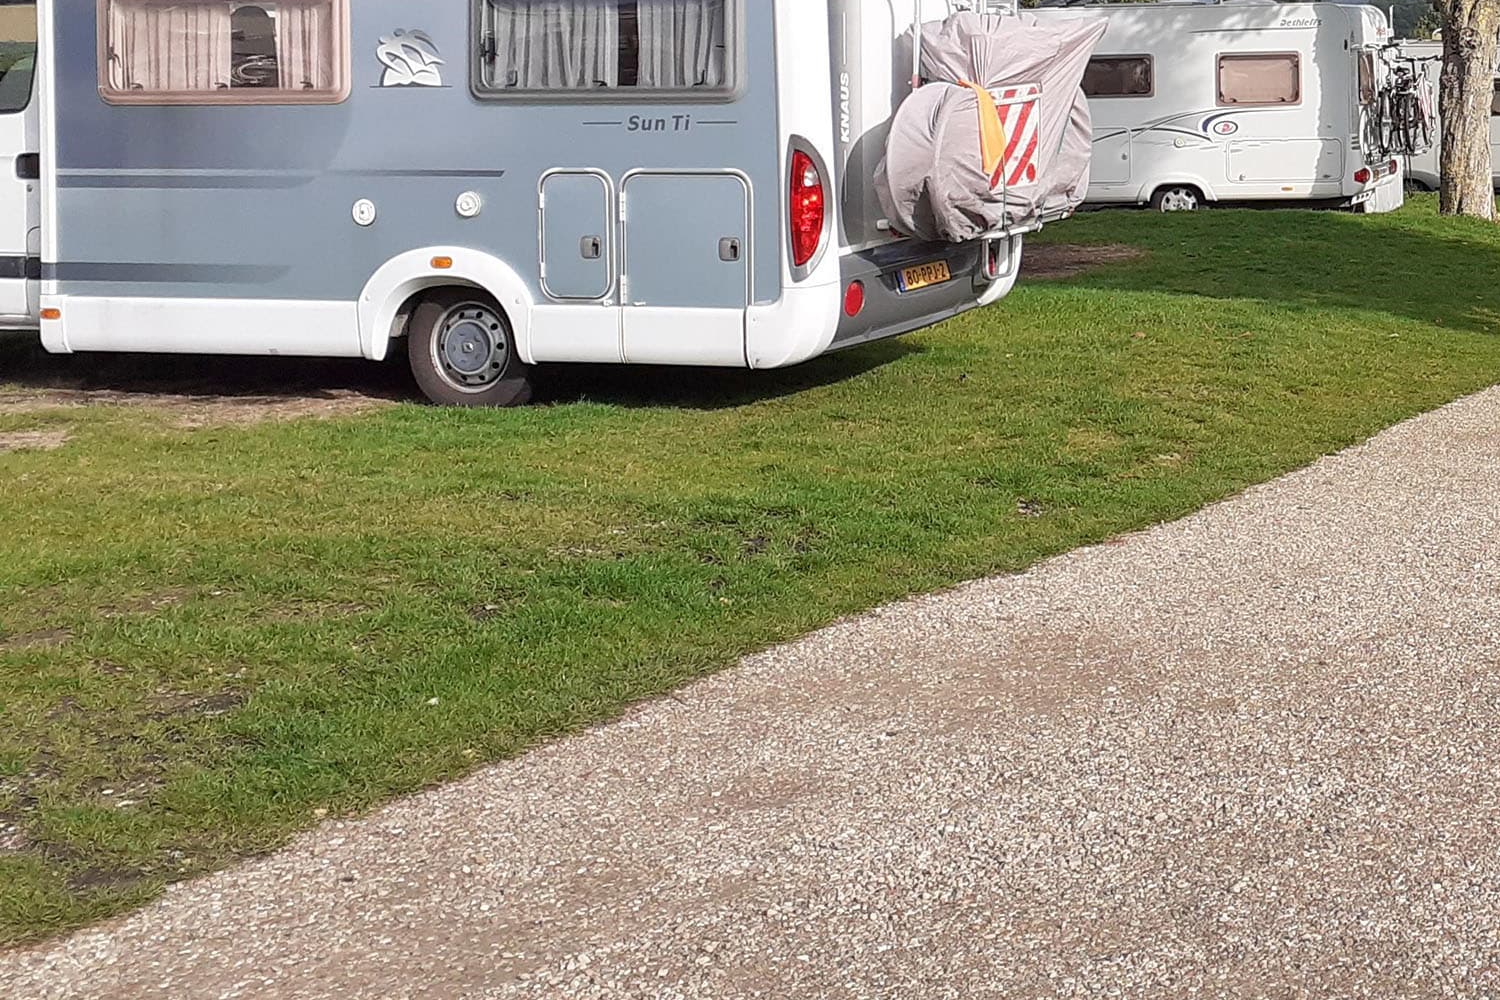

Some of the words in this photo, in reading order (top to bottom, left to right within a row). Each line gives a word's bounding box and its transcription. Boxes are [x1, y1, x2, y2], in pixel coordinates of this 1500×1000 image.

[627, 115, 666, 131] Sun
[671, 114, 691, 131] Ti
[840, 72, 850, 143] KNAUS
